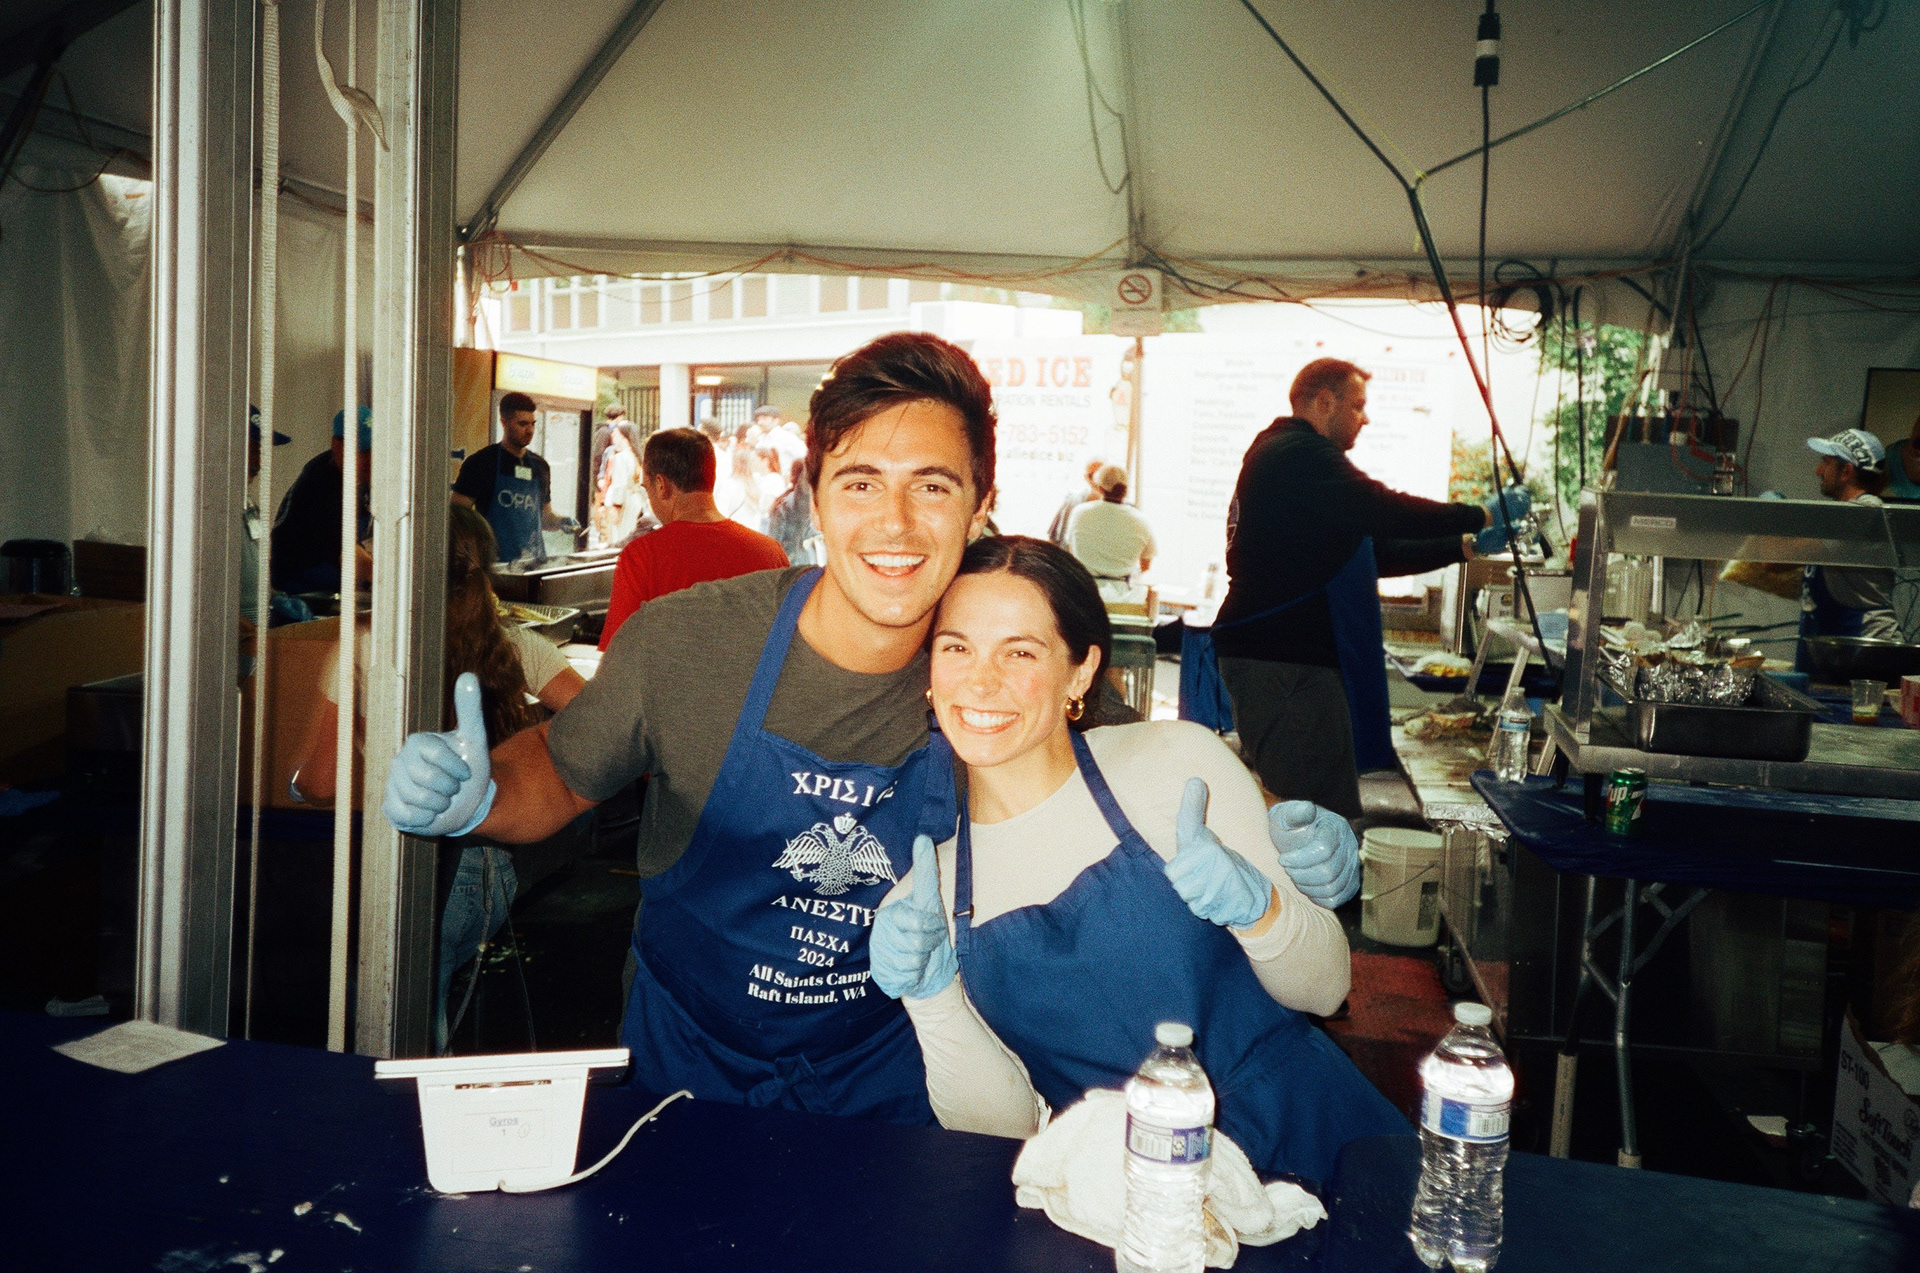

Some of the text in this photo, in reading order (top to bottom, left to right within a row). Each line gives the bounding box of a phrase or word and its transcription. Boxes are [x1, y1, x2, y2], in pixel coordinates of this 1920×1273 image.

[987, 357, 1091, 388] ED ICE
[1608, 783, 1628, 806] up
[790, 926, 850, 953] ΠΑΣΧΑ
[797, 947, 835, 968] 2024
[749, 963, 871, 988] All Saints Camp
[748, 982, 867, 1005] Raft Island, WA
[489, 1116, 519, 1127] Gyros
